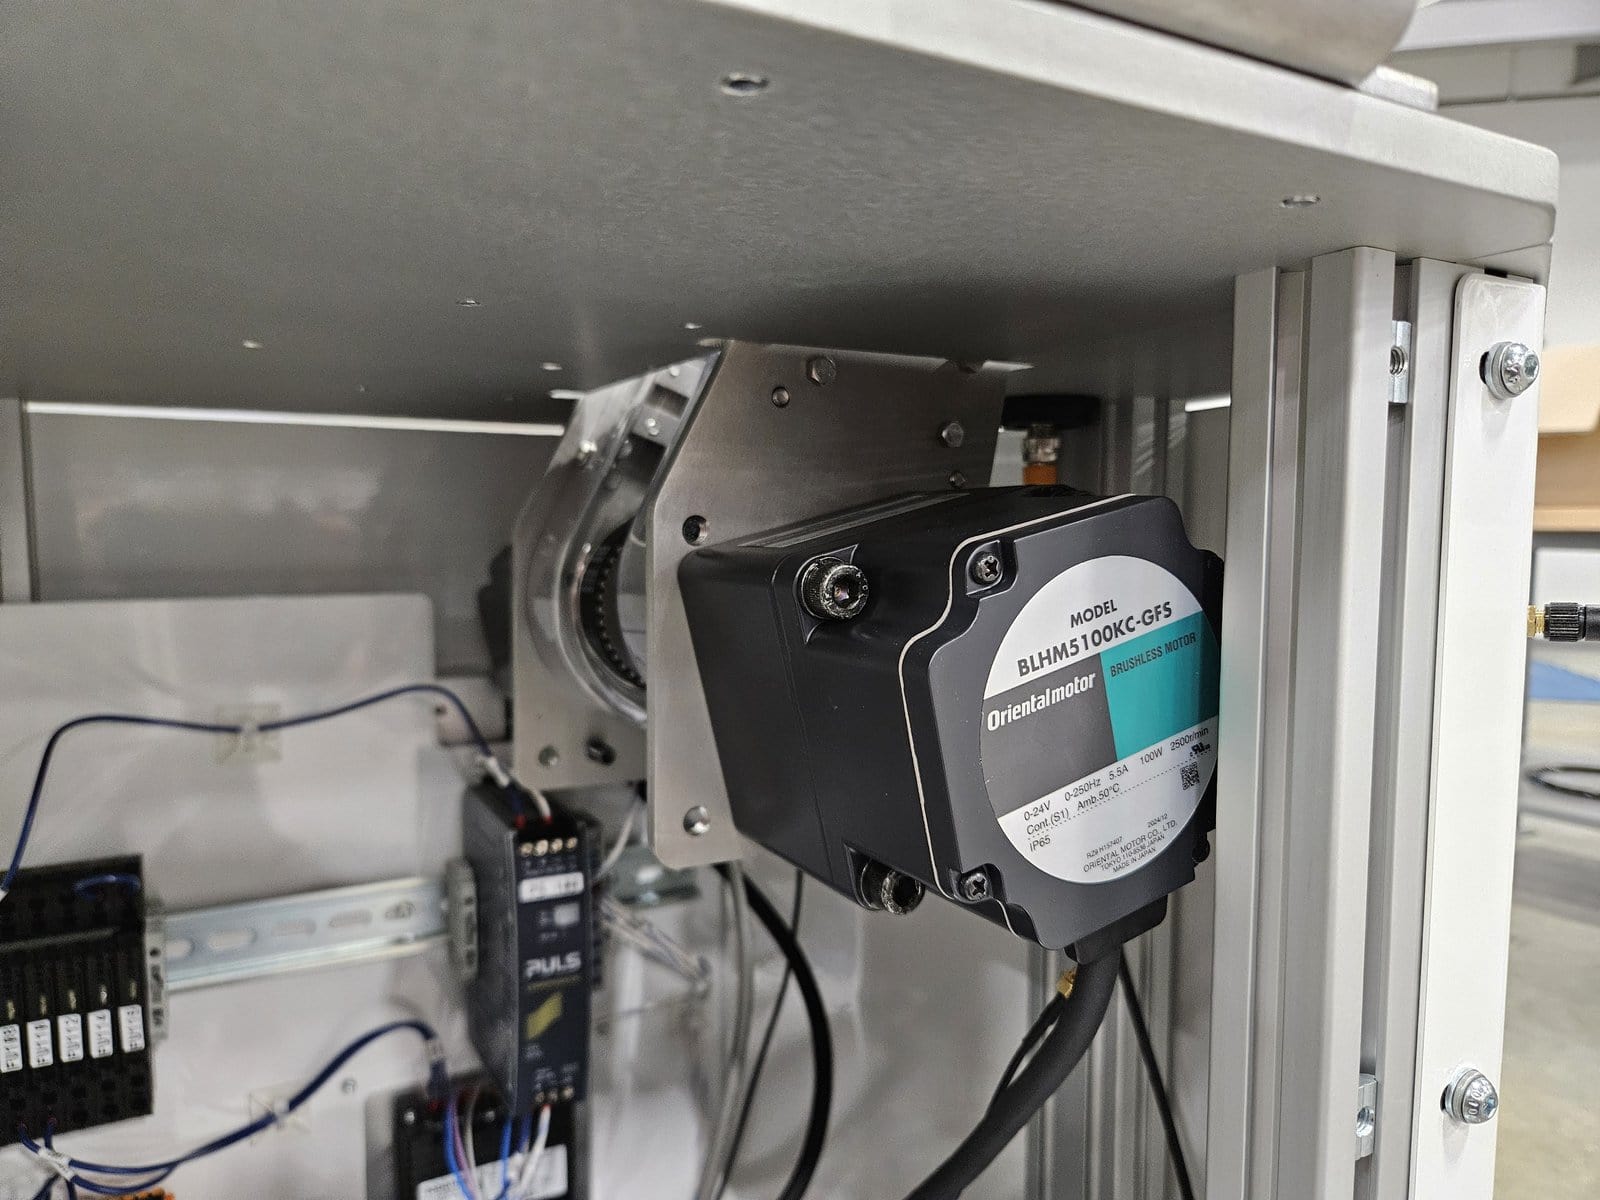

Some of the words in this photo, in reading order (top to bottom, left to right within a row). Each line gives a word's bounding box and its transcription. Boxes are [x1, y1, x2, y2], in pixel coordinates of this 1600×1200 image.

[1070, 599, 1118, 628] MODEL
[1017, 601, 1172, 677] BLHM5100KC-GFS
[1110, 647, 1163, 678] BRUSHLESS
[1165, 632, 1197, 655] MOTOR
[1023, 800, 1051, 821] 0-24V
[1064, 778, 1101, 802] 0-250Hz
[1108, 764, 1129, 781] 5.5A
[1140, 746, 1163, 765] 100W
[1169, 727, 1209, 751] 2500r/min
[1029, 834, 1051, 852] IP65
[1083, 850, 1119, 873] ORIENTAL
[1120, 834, 1147, 854] MOTOR
[1101, 856, 1122, 871] TOKYO
[1112, 861, 1130, 873] MADE
[1137, 846, 1157, 861] JAPAN
[525, 951, 582, 979] PULS
